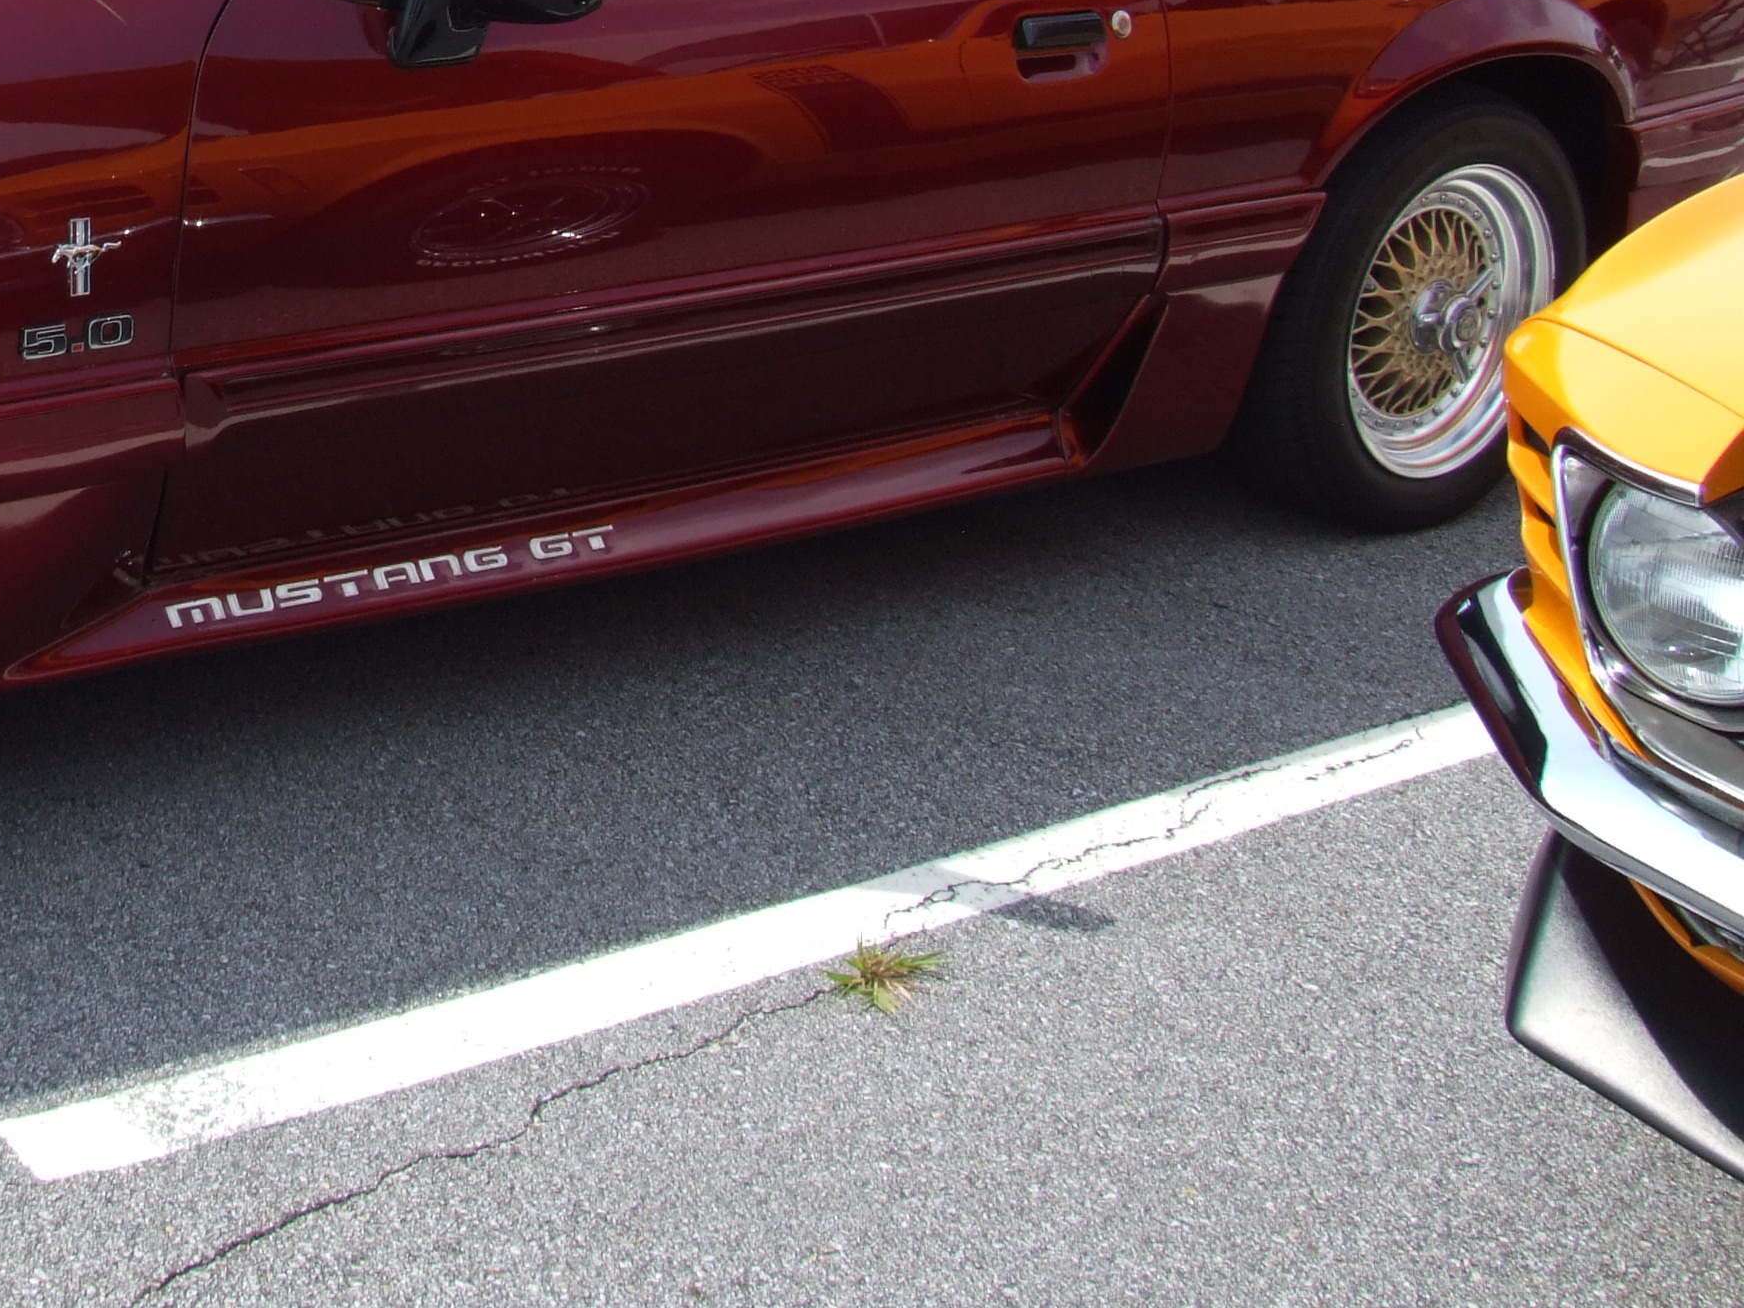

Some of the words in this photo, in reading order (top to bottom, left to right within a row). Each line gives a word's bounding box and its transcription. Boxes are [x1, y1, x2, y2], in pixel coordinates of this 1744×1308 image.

[20, 313, 135, 361] 5.0
[163, 544, 509, 630] MUSTANG
[529, 524, 614, 563] GT
